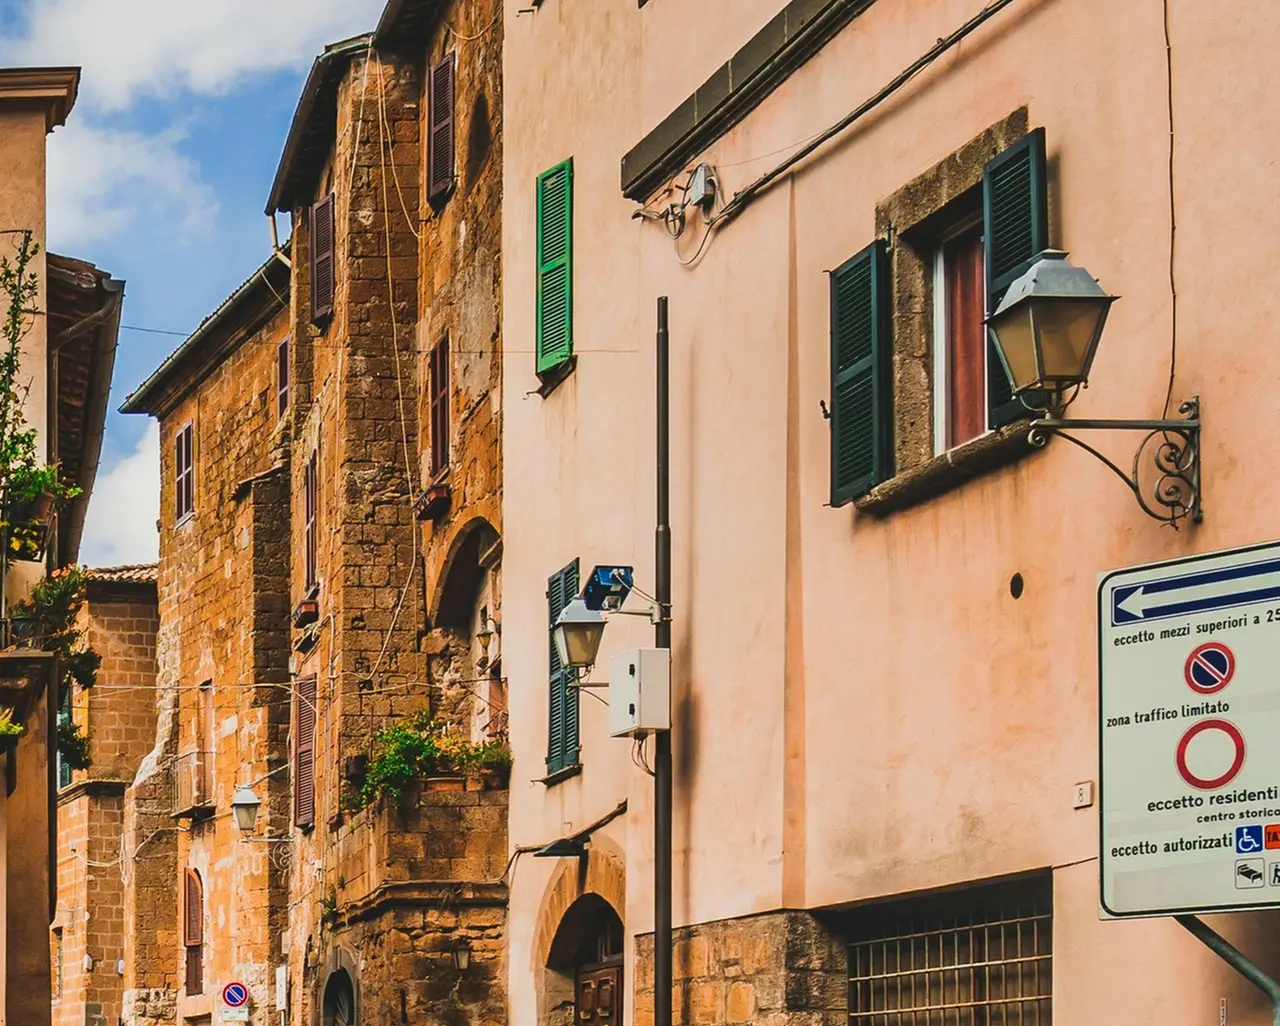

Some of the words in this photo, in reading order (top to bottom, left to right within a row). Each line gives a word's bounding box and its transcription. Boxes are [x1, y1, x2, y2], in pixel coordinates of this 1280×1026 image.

[1114, 631, 1155, 647] eccetto
[1160, 624, 1190, 639] mezzi
[1196, 614, 1247, 635] superiori
[1253, 616, 1260, 625] a
[1107, 716, 1130, 728] zona
[1134, 708, 1178, 723] traffico
[1182, 700, 1229, 718] limitato
[1148, 796, 1204, 812] eccetto
[1209, 786, 1278, 806] residenti
[1197, 812, 1236, 823] centro
[1111, 841, 1158, 857] eccetto
[1164, 833, 1233, 853] autorizzati
[1266, 832, 1280, 843] TA
